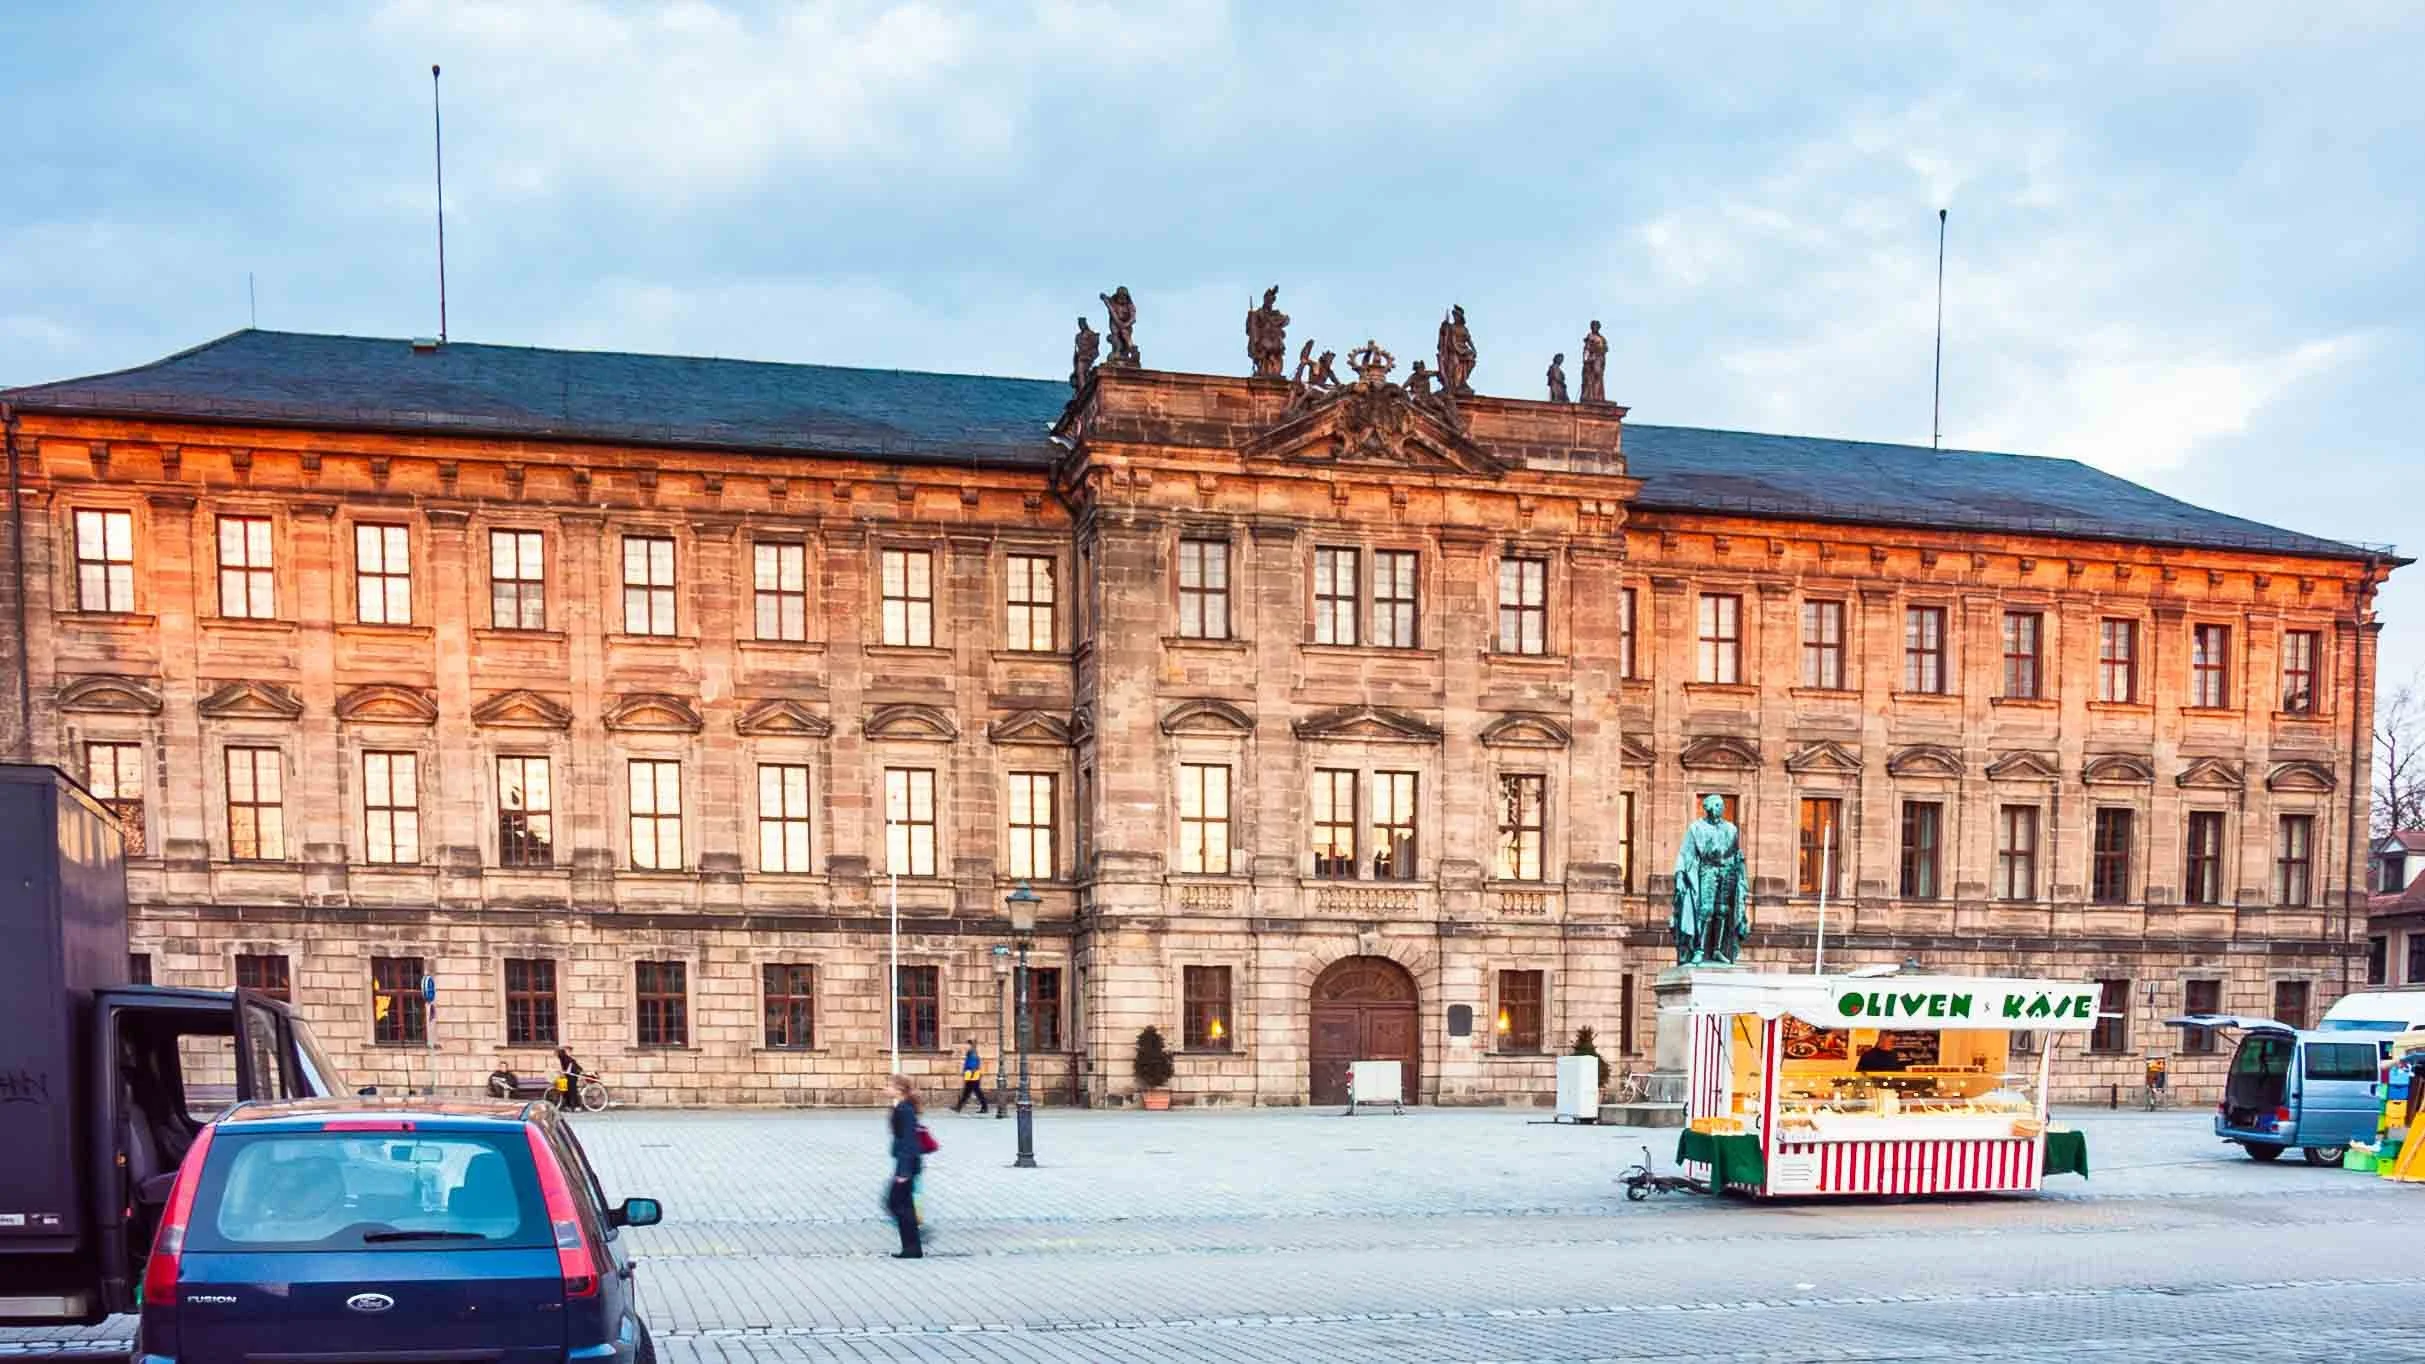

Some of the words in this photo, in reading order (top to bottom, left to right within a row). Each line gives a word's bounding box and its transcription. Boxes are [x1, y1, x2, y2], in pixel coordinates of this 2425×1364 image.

[1838, 992, 1973, 1019] OLIVEN
[2002, 991, 2093, 1019] KÄSE
[187, 1295, 237, 1303] FUSION
